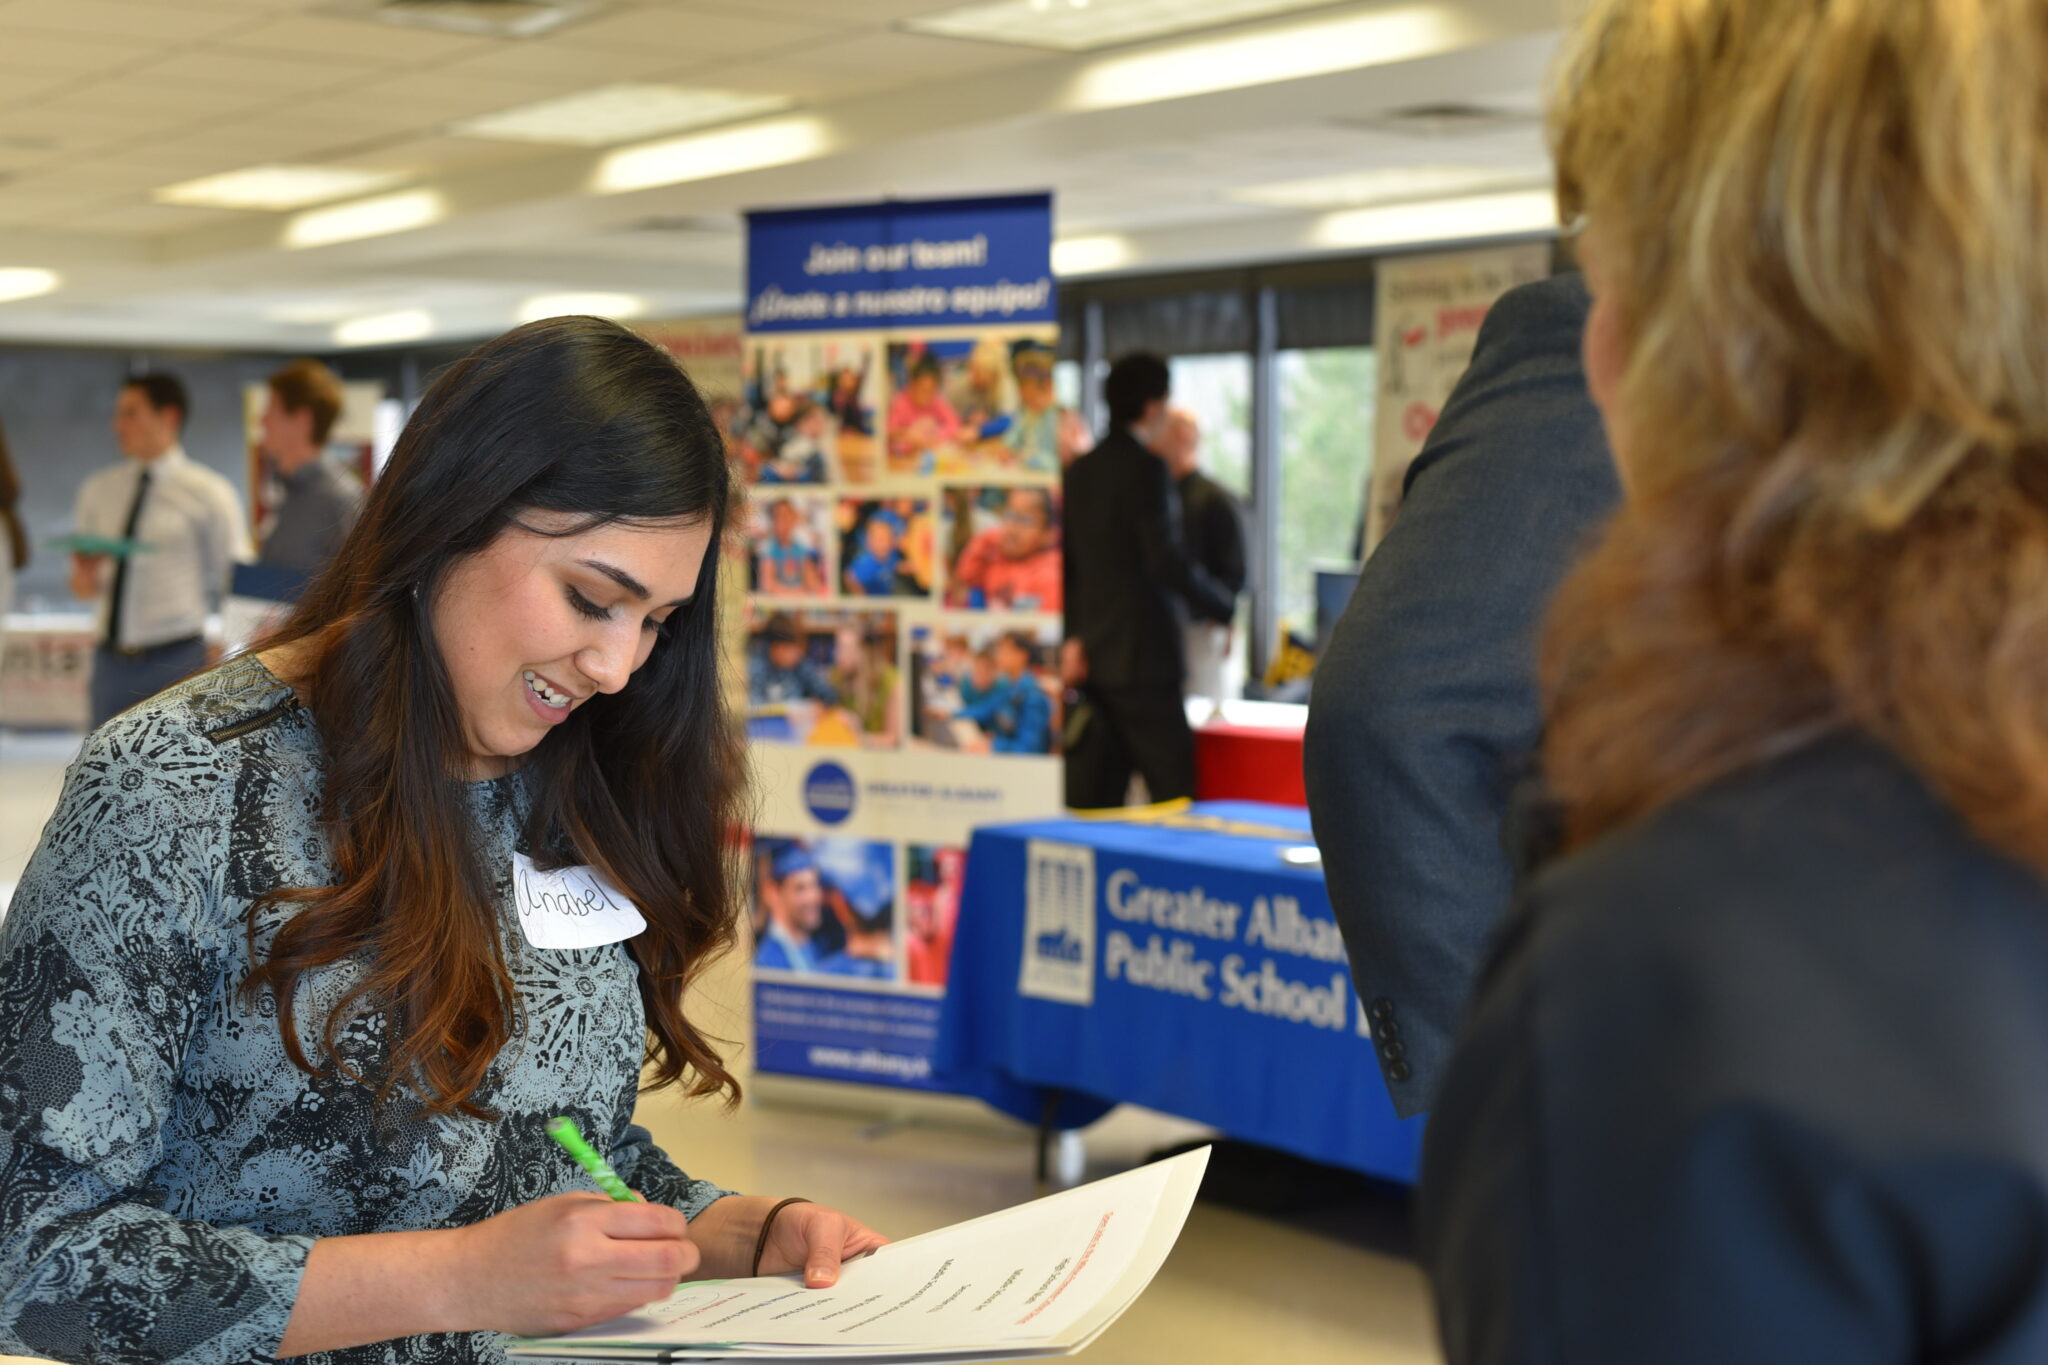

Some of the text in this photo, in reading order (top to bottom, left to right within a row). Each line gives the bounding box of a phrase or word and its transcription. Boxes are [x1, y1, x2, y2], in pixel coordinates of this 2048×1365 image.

[804, 233, 987, 275] Join our team!
[855, 285, 949, 316] nuestro
[952, 278, 1049, 317] equipo!
[519, 868, 621, 917] Anabel
[1106, 869, 1350, 966] Greater Alban
[1105, 931, 1214, 1001] Public
[1220, 954, 1346, 1030] School
